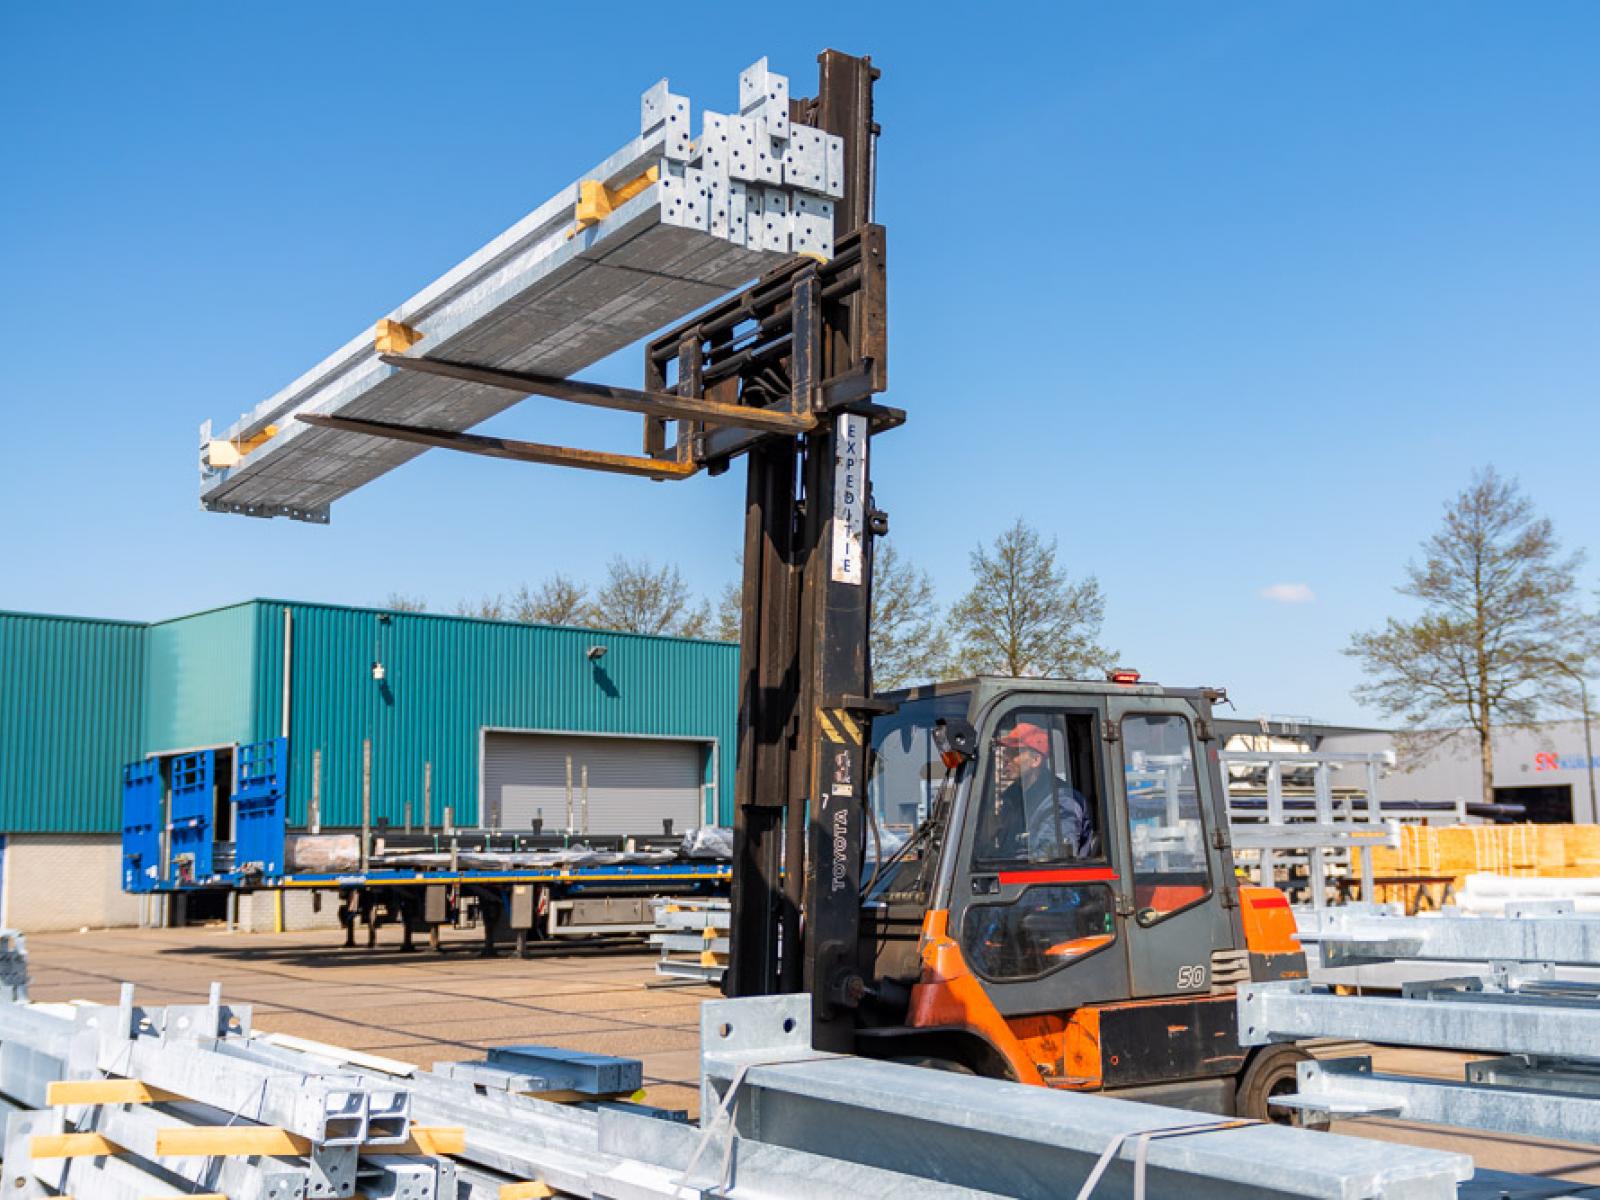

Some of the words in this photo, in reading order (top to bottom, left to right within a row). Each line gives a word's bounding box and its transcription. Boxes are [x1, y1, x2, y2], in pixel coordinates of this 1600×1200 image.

[843, 424, 857, 573] EXPEDITIE
[832, 809, 848, 892] TOYOTA
[1177, 965, 1205, 987] 50
